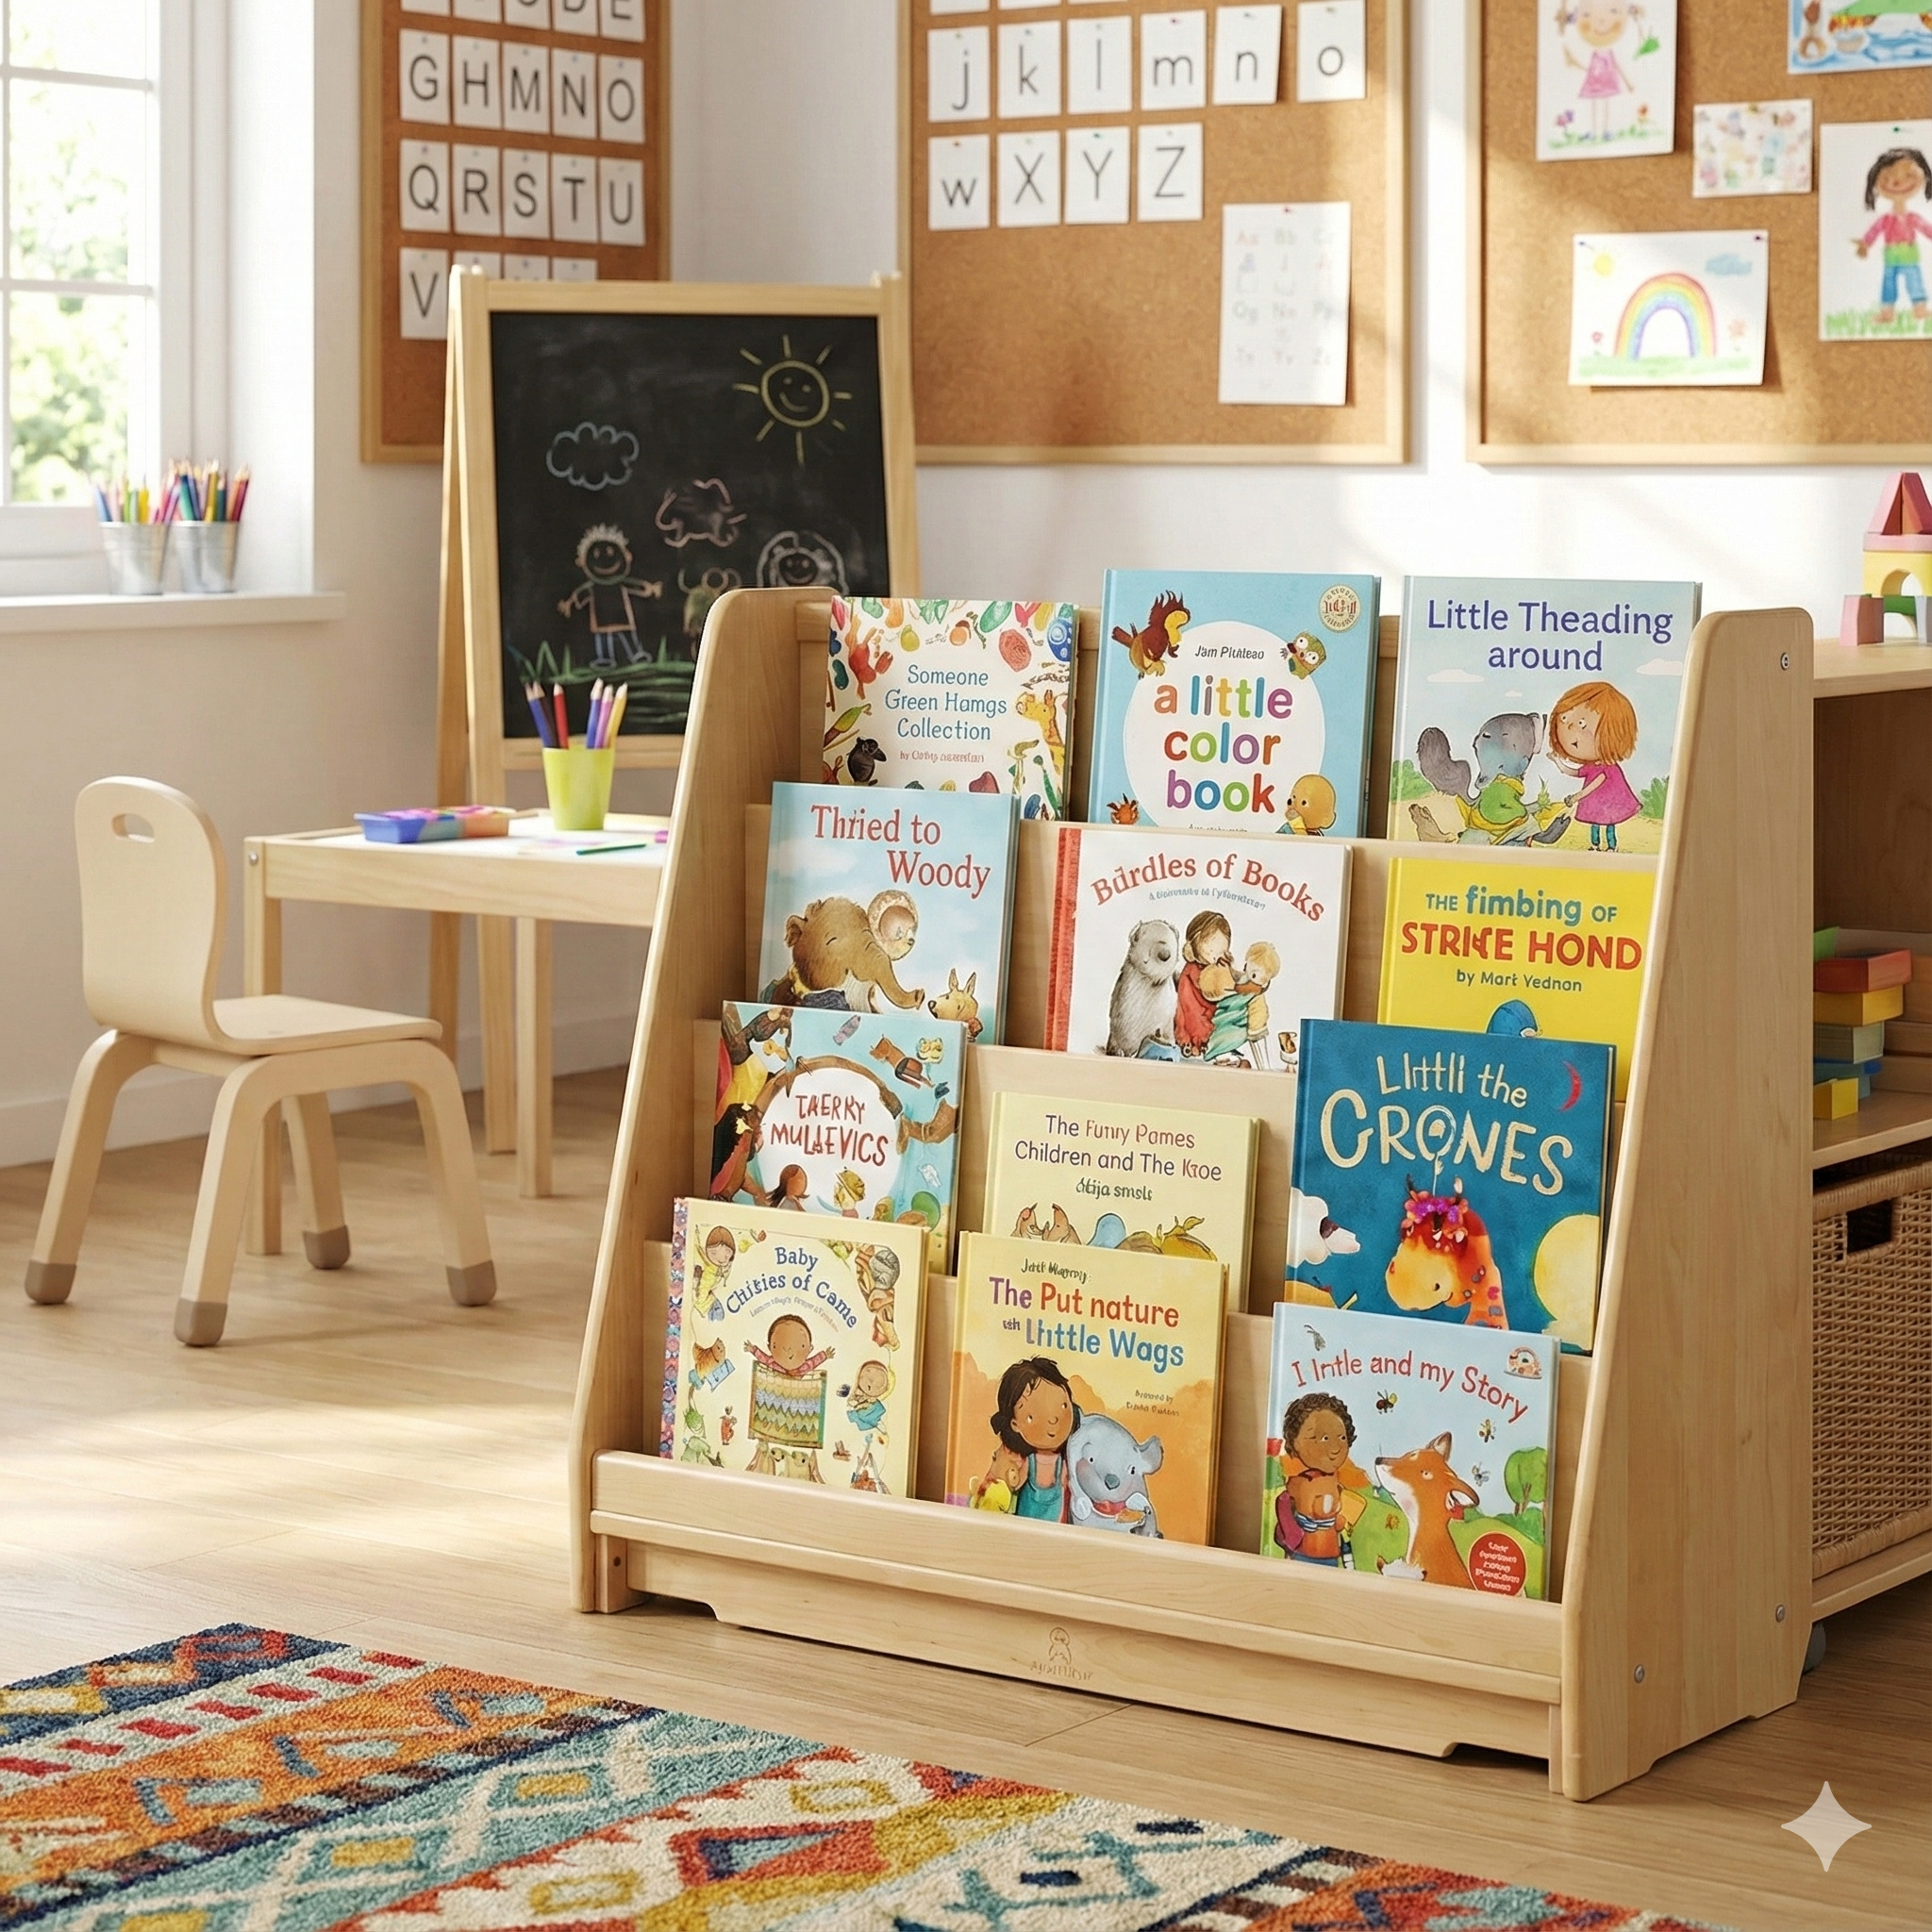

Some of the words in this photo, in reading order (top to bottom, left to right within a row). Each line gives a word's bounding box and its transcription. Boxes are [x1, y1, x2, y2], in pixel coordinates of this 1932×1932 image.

[409, 55, 439, 101] G
[463, 60, 489, 108] H
[510, 67, 541, 112] M
[562, 74, 586, 118] N
[607, 79, 635, 123] O
[951, 49, 970, 110] j
[1019, 44, 1039, 94] k
[1153, 53, 1193, 87] m
[1236, 51, 1257, 82] n
[1318, 45, 1343, 76] o
[408, 164, 440, 214] Q
[463, 169, 490, 216] R
[513, 173, 538, 218] S
[562, 176, 585, 222] T
[608, 180, 633, 225] U
[1014, 153, 1044, 205] X
[1083, 150, 1113, 201] Y
[1154, 146, 1186, 198] Z
[410, 272, 440, 319] V
[1428, 599, 1508, 631] Little
[1518, 602, 1673, 644] Theading
[908, 664, 989, 686] Someone
[1488, 641, 1603, 671] around
[885, 689, 938, 711] Green
[1154, 684, 1178, 714] a
[1191, 675, 1293, 719] little
[896, 717, 991, 741] Collection
[1164, 721, 1281, 765] color
[1167, 769, 1275, 814] book
[910, 814, 941, 845] to
[887, 850, 991, 899] Woody
[1207, 853, 1237, 879] of
[1241, 859, 1324, 922] Books
[1425, 893, 1458, 911] THE
[1465, 885, 1582, 926] fimbing
[1591, 906, 1618, 923] OF
[1528, 930, 1642, 970] HOND
[1457, 969, 1475, 987] by
[1477, 1063, 1527, 1108] the
[1045, 1114, 1079, 1137] The
[1015, 1141, 1091, 1167] Children
[1098, 1151, 1133, 1172] and
[1140, 1153, 1174, 1175] The
[774, 1246, 818, 1273] Baby
[792, 1274, 812, 1291] of
[990, 1276, 1032, 1309] The
[1041, 1282, 1083, 1315] Put
[1091, 1294, 1179, 1328] nature
[1109, 1328, 1185, 1374] Wags
[1370, 1350, 1412, 1377] and
[1420, 1360, 1455, 1392] my
[1461, 1366, 1528, 1424] Story
